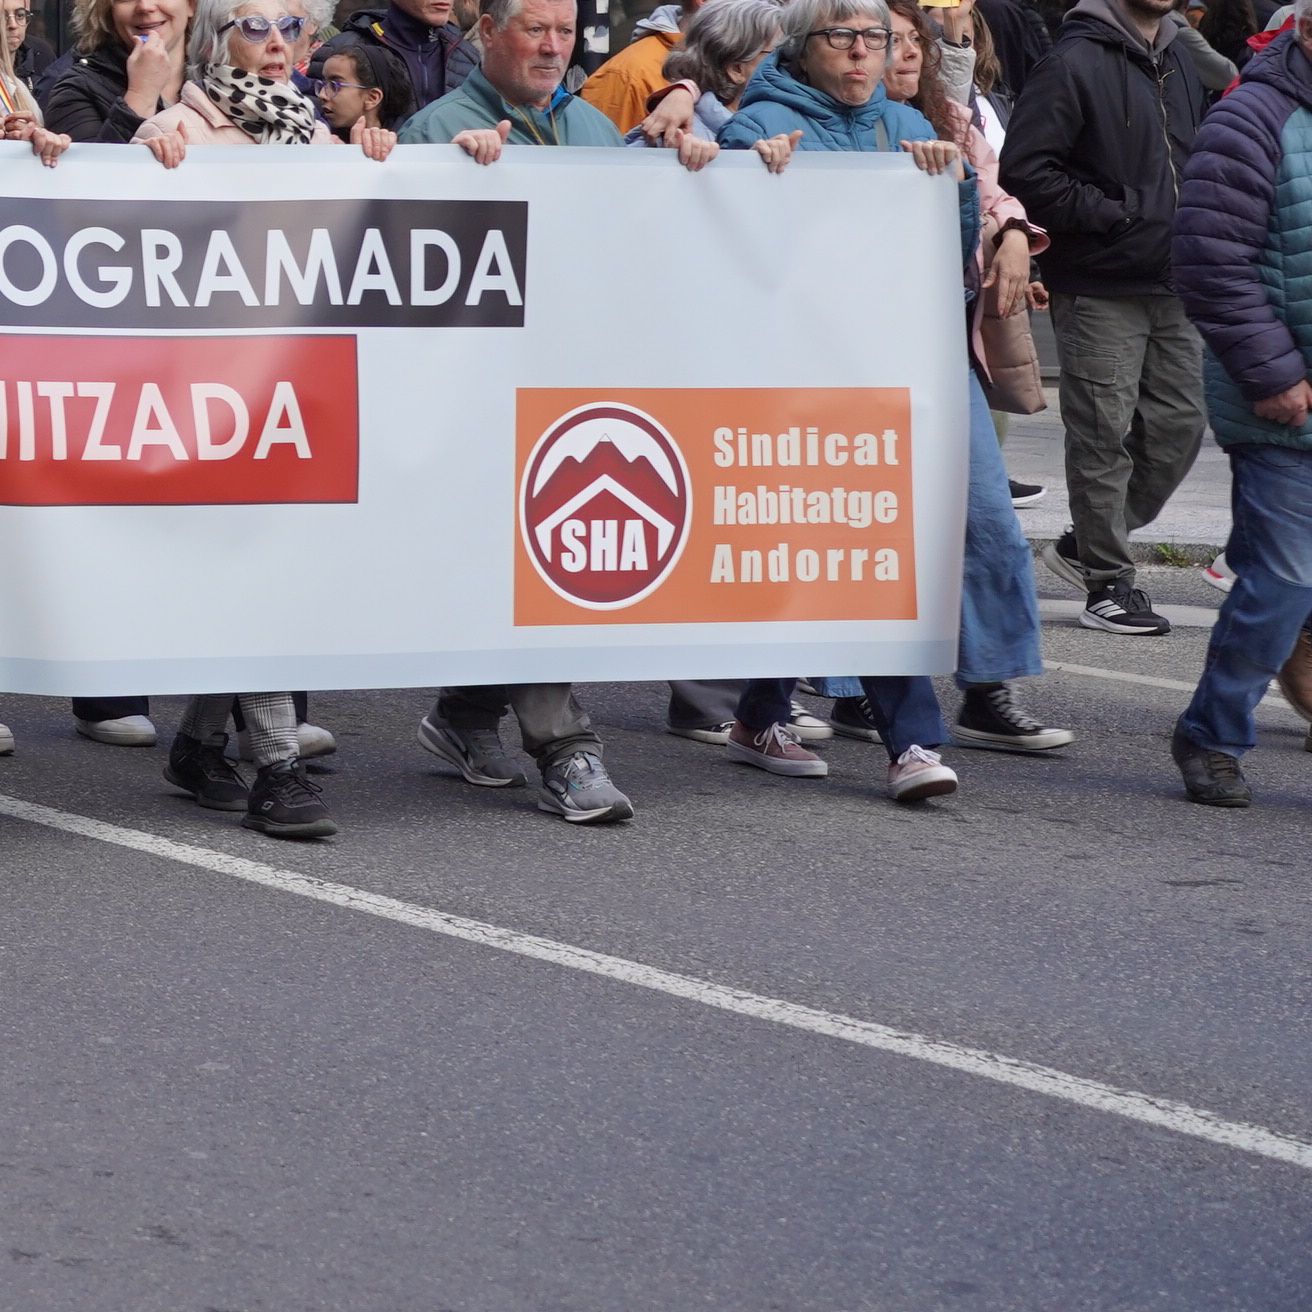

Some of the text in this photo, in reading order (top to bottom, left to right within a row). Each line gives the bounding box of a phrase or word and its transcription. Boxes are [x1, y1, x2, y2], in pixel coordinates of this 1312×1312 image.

[713, 427, 899, 467] Sindicat
[713, 485, 899, 528] Habitatge
[560, 519, 648, 572] SHA
[710, 543, 899, 583] Andorra
